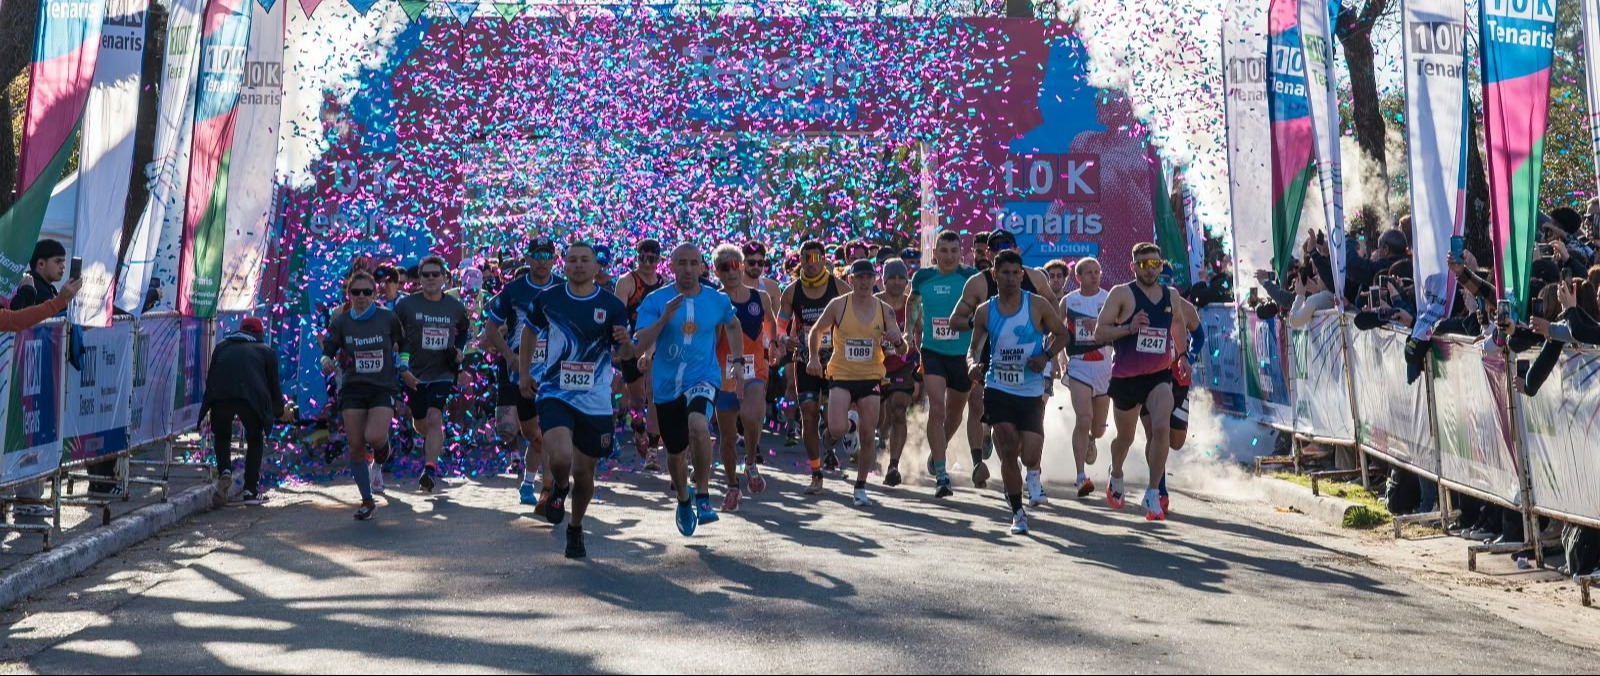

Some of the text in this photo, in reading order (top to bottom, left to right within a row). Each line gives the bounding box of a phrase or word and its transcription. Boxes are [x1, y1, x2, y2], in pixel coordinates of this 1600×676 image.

[102, 31, 142, 51] enaris
[1487, 20, 1554, 49] Tenaris
[206, 46, 246, 73] 10K
[1274, 46, 1303, 75] 10
[1413, 58, 1462, 79] Tenar
[243, 62, 280, 86] 0K
[1231, 58, 1266, 82] 10
[203, 76, 242, 93] Tenaris
[1270, 77, 1307, 96] Tena
[240, 90, 280, 105] enaris
[1001, 159, 1096, 196] 10K
[988, 208, 1103, 235] Tenaris
[424, 314, 451, 324] Tenaris
[354, 335, 383, 347] Tenaris
[425, 337, 445, 346] 3141
[1141, 338, 1164, 349] 4247
[849, 347, 870, 357] 1089
[358, 360, 381, 370] 3579
[564, 373, 590, 385] 3432
[999, 371, 1019, 383] 1101
